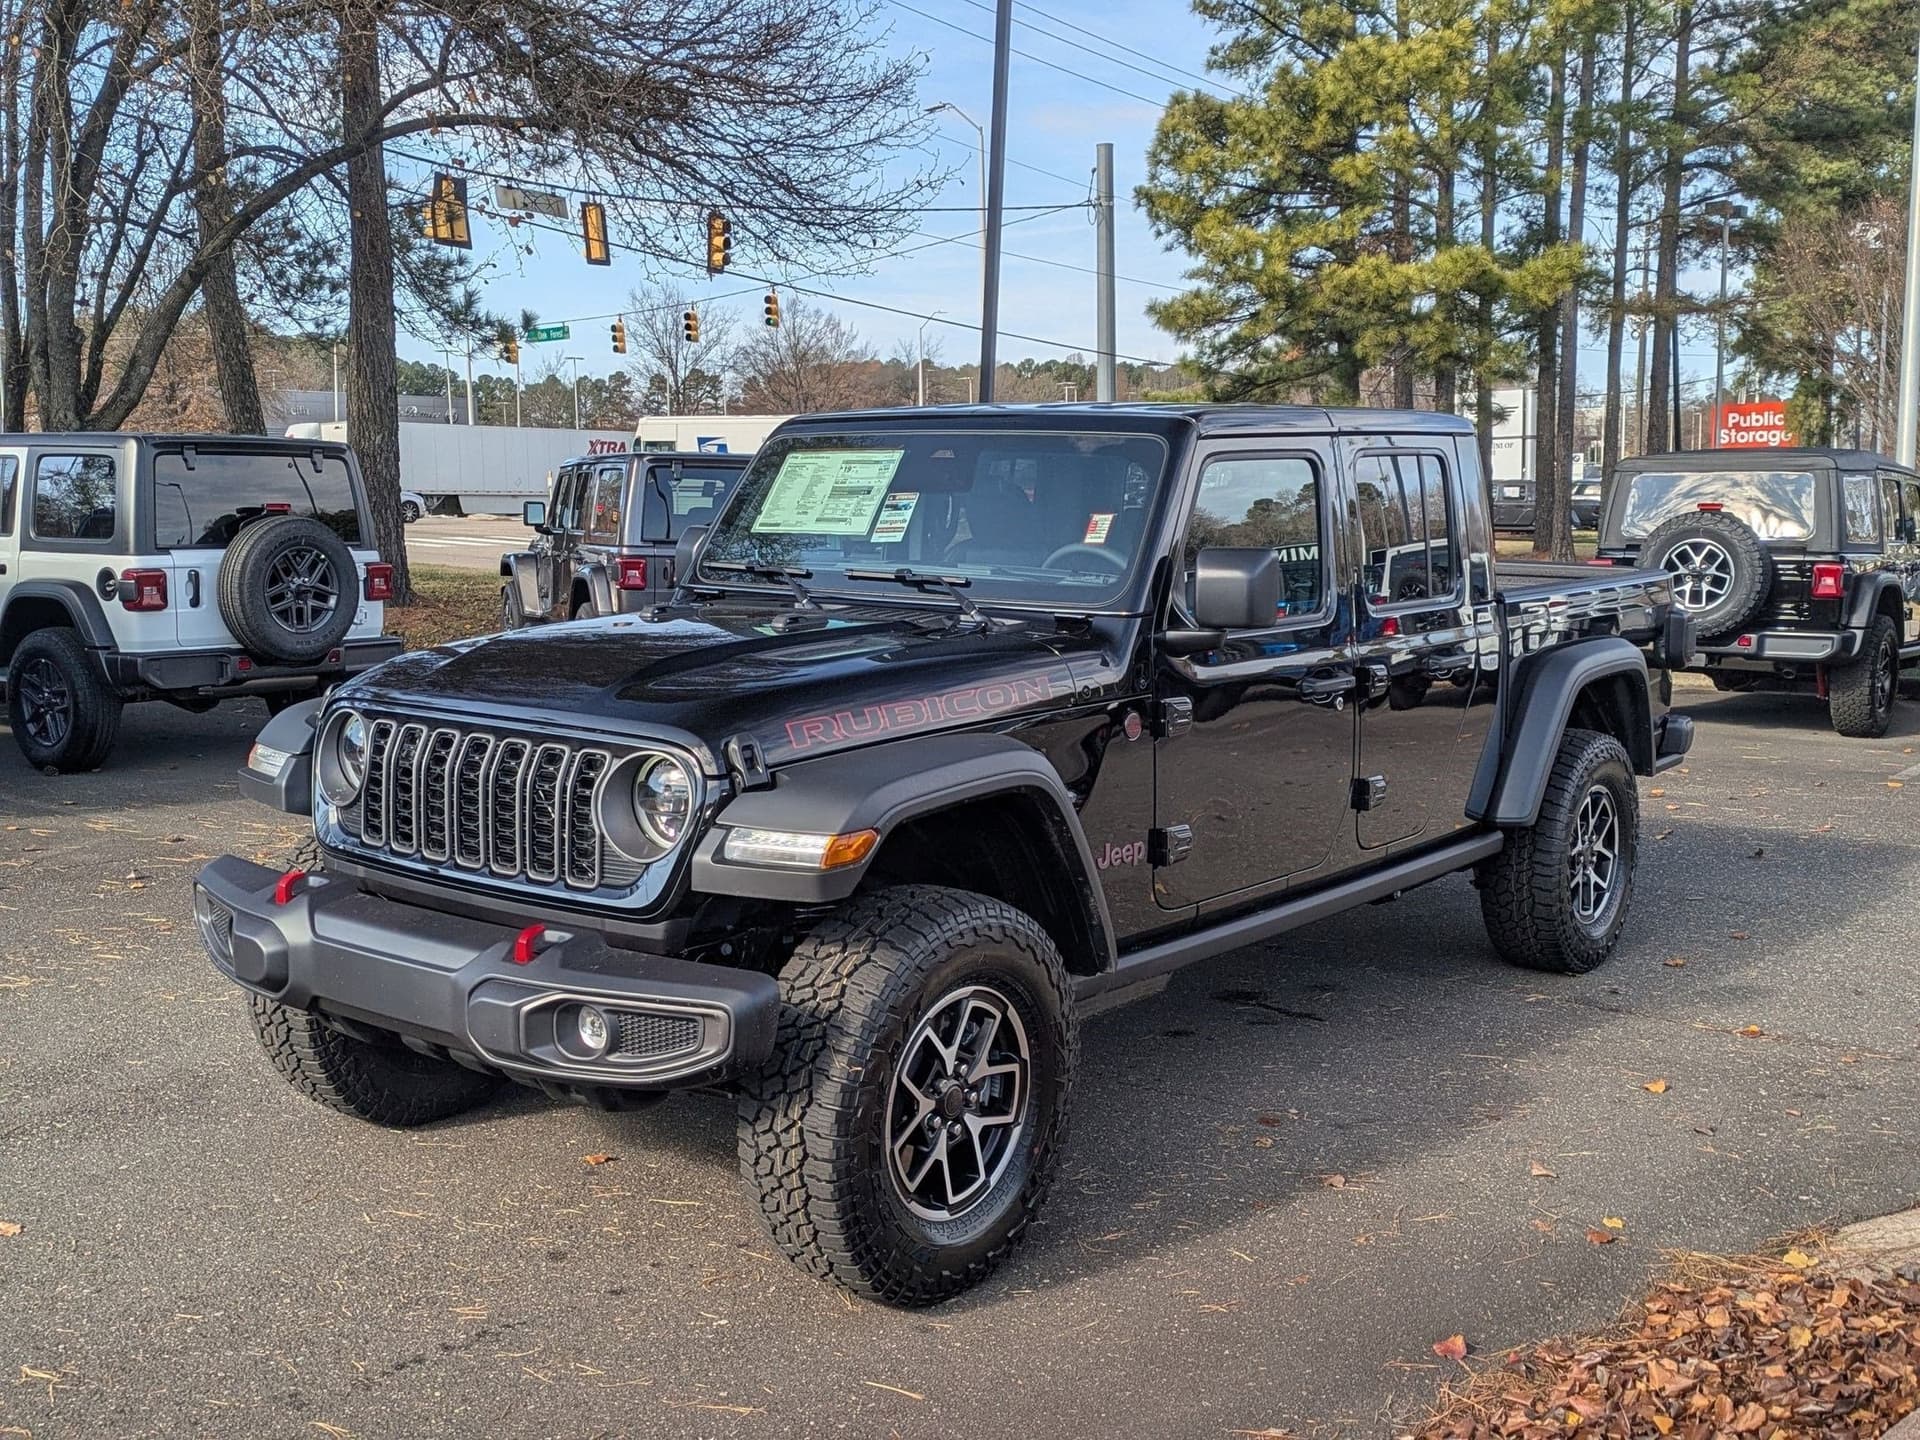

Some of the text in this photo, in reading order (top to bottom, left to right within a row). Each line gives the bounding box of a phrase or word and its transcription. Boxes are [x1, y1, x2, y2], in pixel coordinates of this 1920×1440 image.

[1727, 411, 1785, 428] Public
[587, 438, 627, 455] XTRA
[1720, 427, 1793, 447] Storage
[785, 677, 1052, 749] RUBICON
[1096, 840, 1146, 870] Jeep
